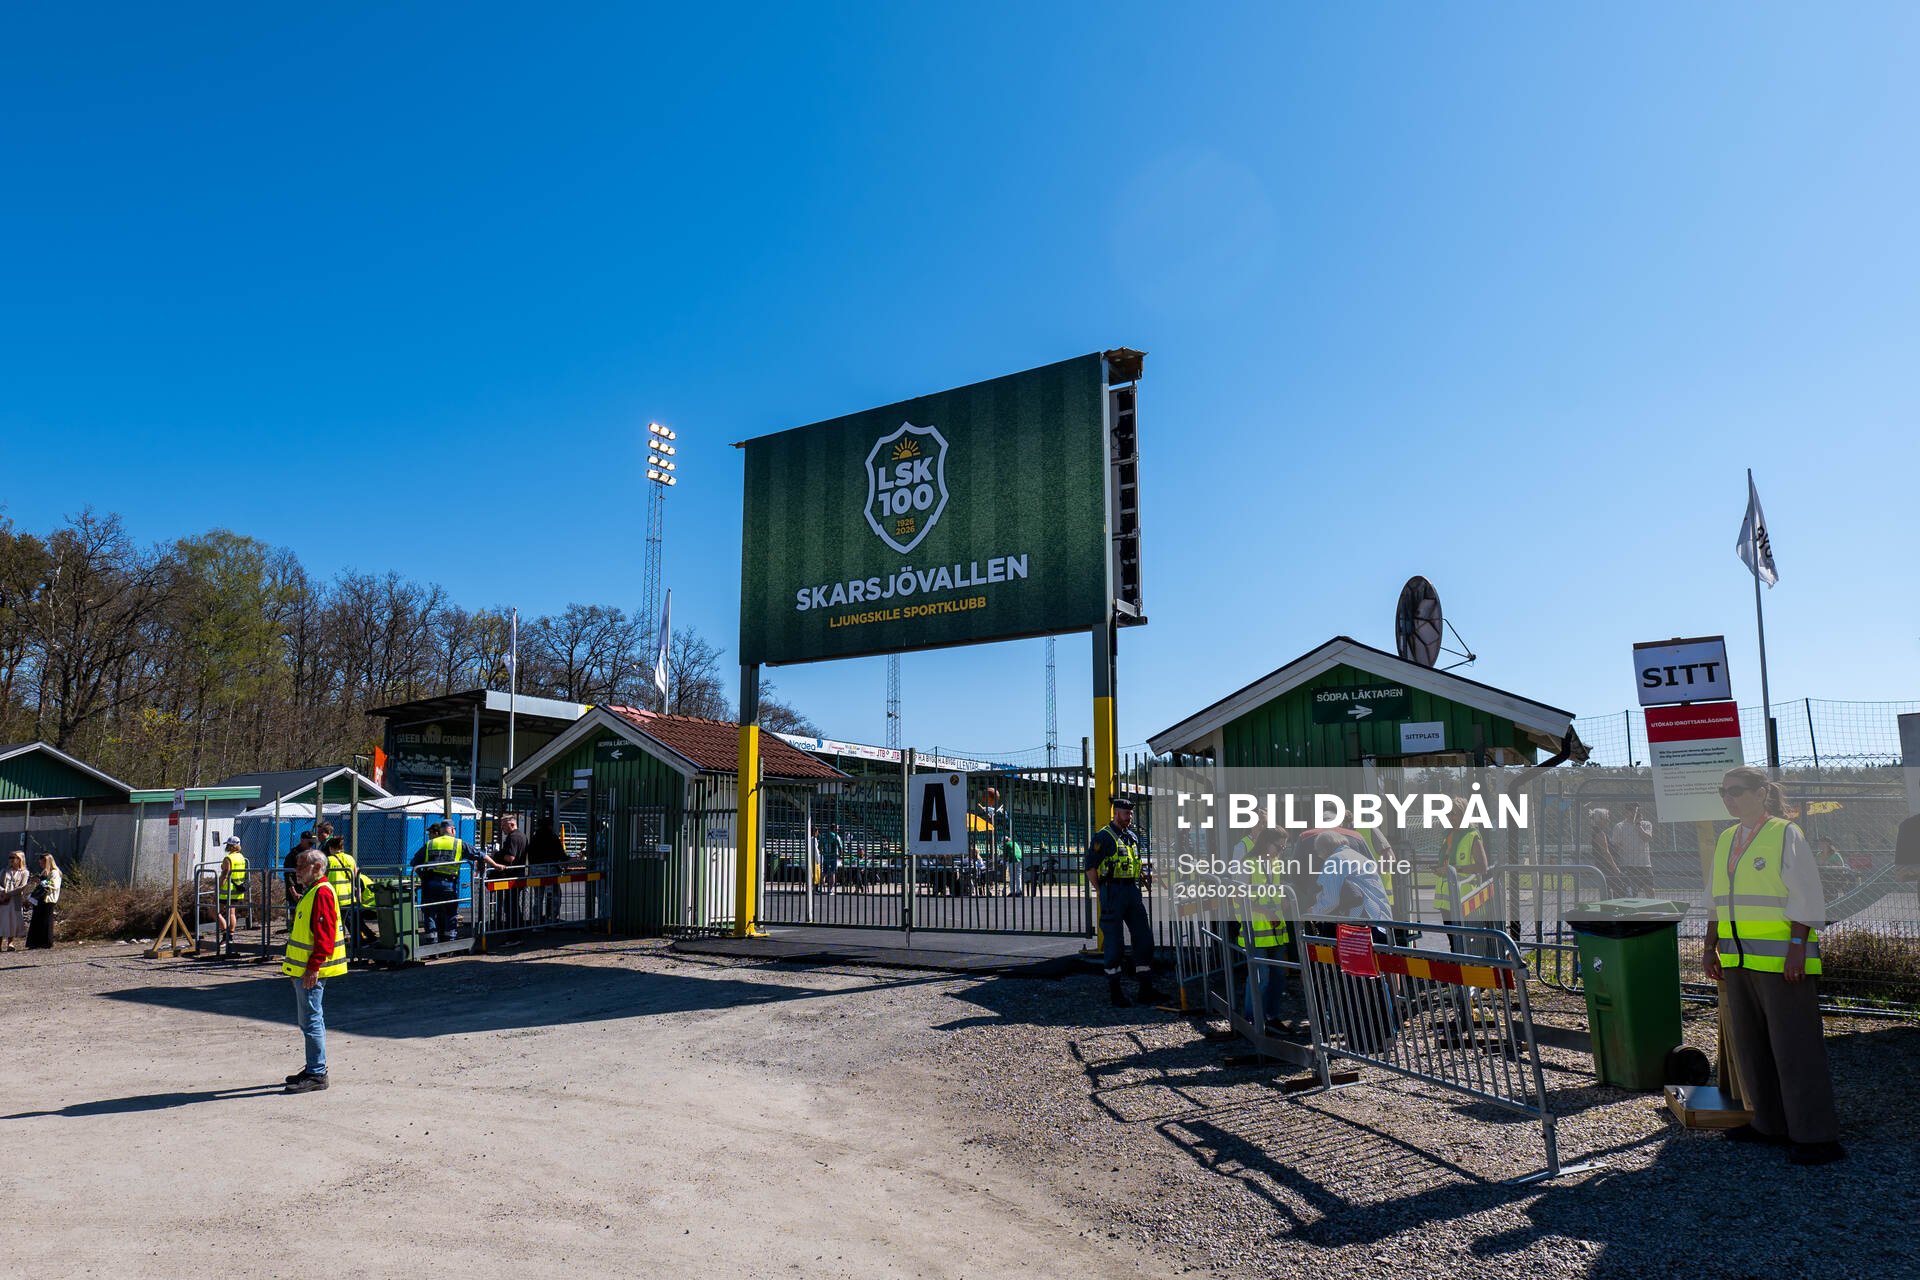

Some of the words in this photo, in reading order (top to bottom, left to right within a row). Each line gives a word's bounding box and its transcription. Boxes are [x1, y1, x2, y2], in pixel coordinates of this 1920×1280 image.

[878, 457, 934, 491] LSK
[879, 483, 934, 517] 100
[895, 525, 916, 536] 2026
[896, 517, 915, 527] 1926
[796, 554, 1028, 611] SKARSJÖVALLEN
[829, 608, 901, 628] LJUNGSKILE
[903, 596, 987, 618] SPORTKLUBB
[1642, 662, 1720, 688] SITT
[1316, 690, 1349, 702] SÖDRA
[1352, 688, 1404, 700] LÄKTAREN
[1405, 732, 1440, 741] SITTPLATS
[1651, 720, 1674, 728] UTÖKAD
[919, 783, 951, 842] A
